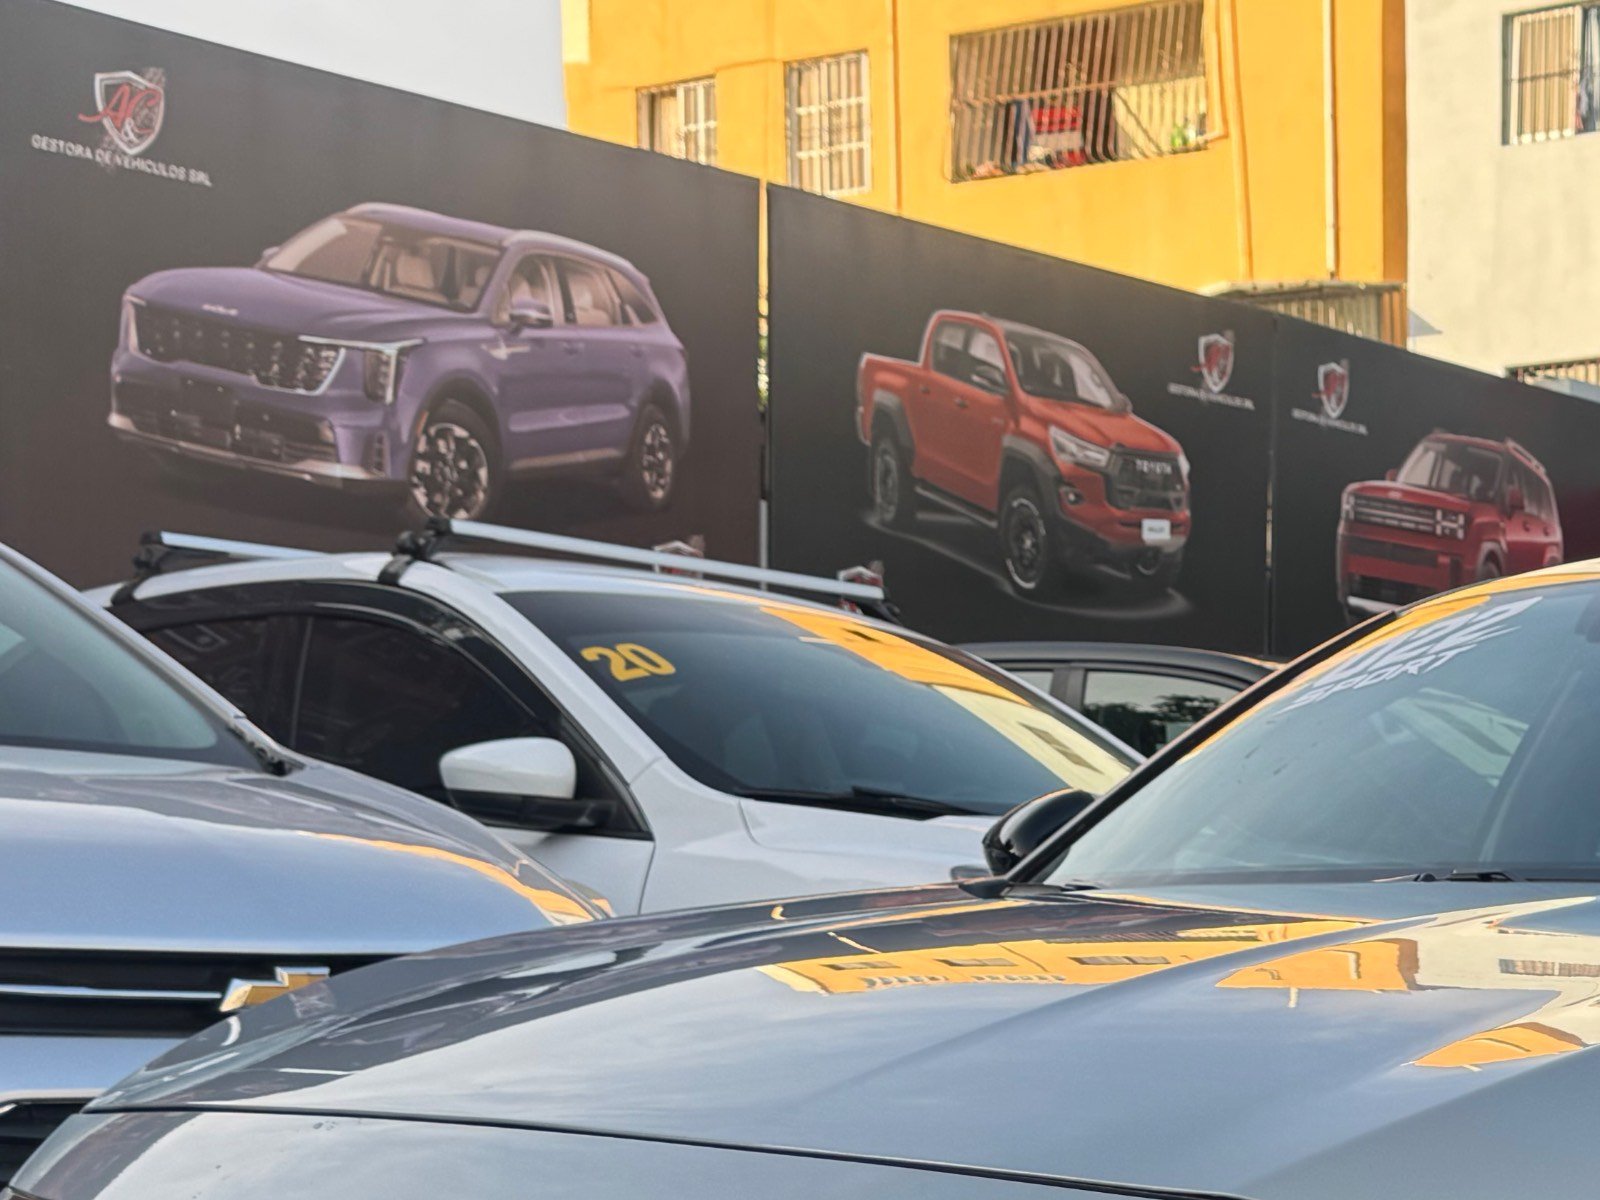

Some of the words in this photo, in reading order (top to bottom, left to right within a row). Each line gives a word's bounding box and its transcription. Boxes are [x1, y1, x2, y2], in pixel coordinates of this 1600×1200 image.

[31, 133, 93, 160] GESTORA
[580, 642, 677, 682] 20
[1274, 643, 1478, 716] SPORT
